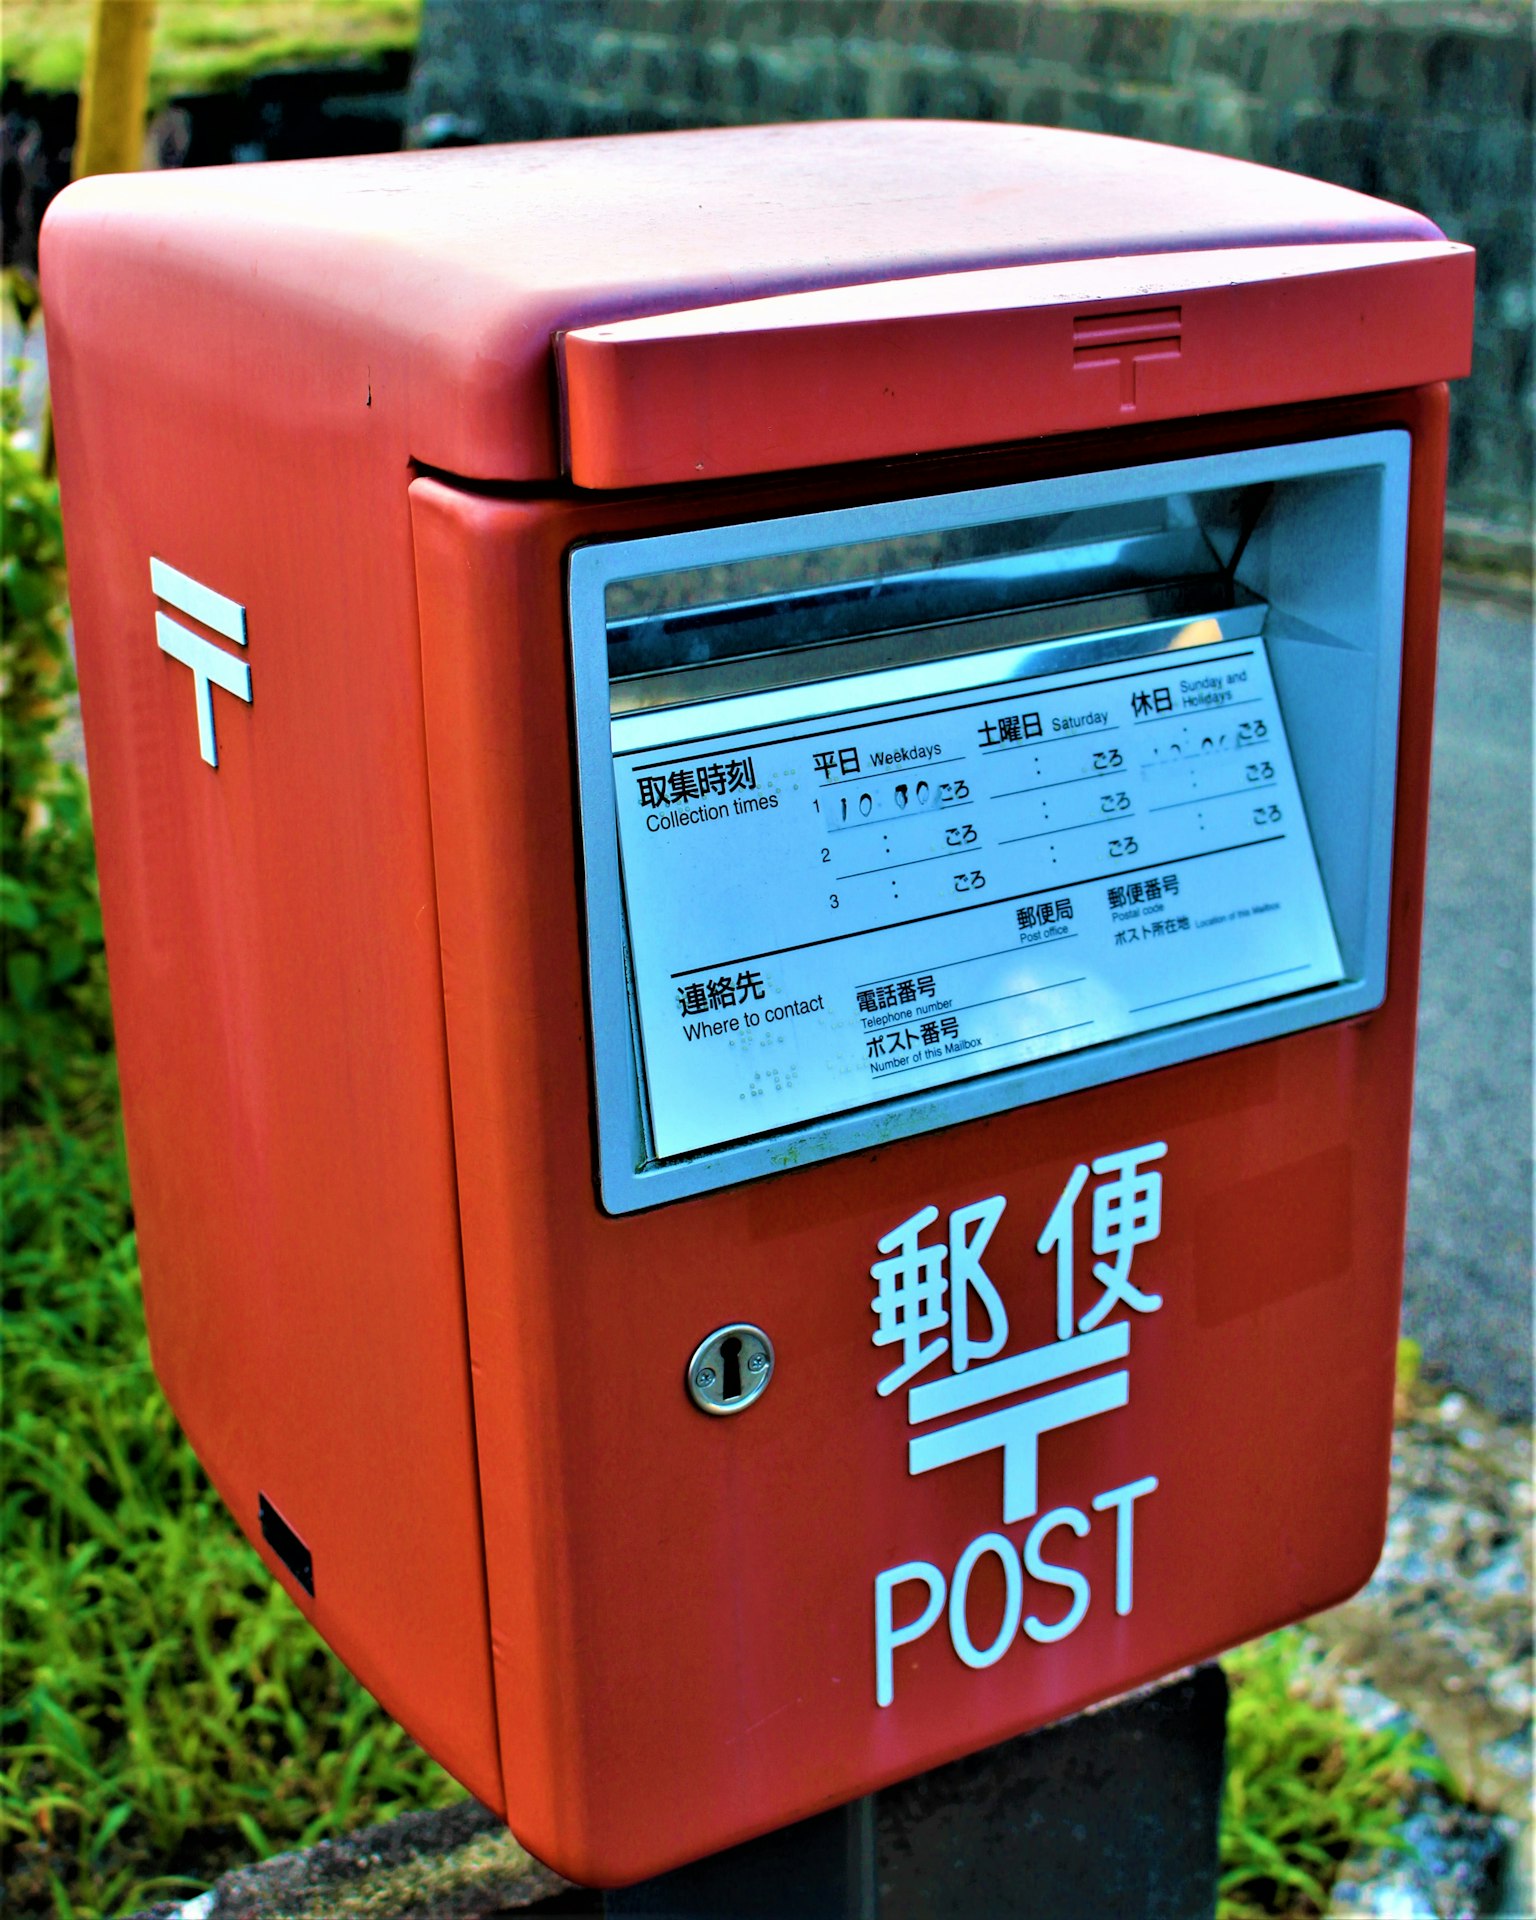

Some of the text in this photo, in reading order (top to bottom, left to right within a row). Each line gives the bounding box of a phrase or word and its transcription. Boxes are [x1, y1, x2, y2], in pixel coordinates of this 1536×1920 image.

[1180, 669, 1247, 693] Sunday and
[1131, 687, 1174, 718] 休日
[1182, 690, 1232, 709] Holidays
[977, 712, 1043, 748] 土曜日
[1052, 710, 1109, 732] Saturday
[1238, 720, 1268, 740] ごろ
[813, 747, 860, 780] 平日
[870, 744, 941, 767] Weekdays
[1092, 748, 1123, 770] ごろ
[637, 756, 756, 809] 取集時刻
[1246, 761, 1275, 782] ごろ
[939, 780, 970, 802] ごろ
[1100, 792, 1131, 813] ごろ
[646, 792, 778, 833] Collection times
[812, 798, 820, 814] 1
[1253, 805, 1282, 826] ごろ
[945, 824, 978, 847] ごろ
[1108, 836, 1139, 858] ごろ
[821, 848, 831, 863] 2
[953, 870, 986, 893] ごろ
[1107, 874, 1180, 909] 郵便番号
[829, 894, 840, 910] 3
[1112, 902, 1165, 922] Postal code
[1016, 898, 1073, 930] 郵便局
[1020, 925, 1069, 944] Post office
[1114, 915, 1191, 946] ポスト所在地
[677, 970, 766, 1018] 連絡先
[856, 975, 936, 1012] 電話番号
[683, 994, 824, 1042] Where to contact
[861, 999, 953, 1029] Telephone number
[866, 1016, 959, 1058] ポスト番号
[870, 1037, 982, 1073] Number of this Mailbox
[870, 1141, 1168, 1397] 郵便
[875, 1475, 1158, 1708] POST
